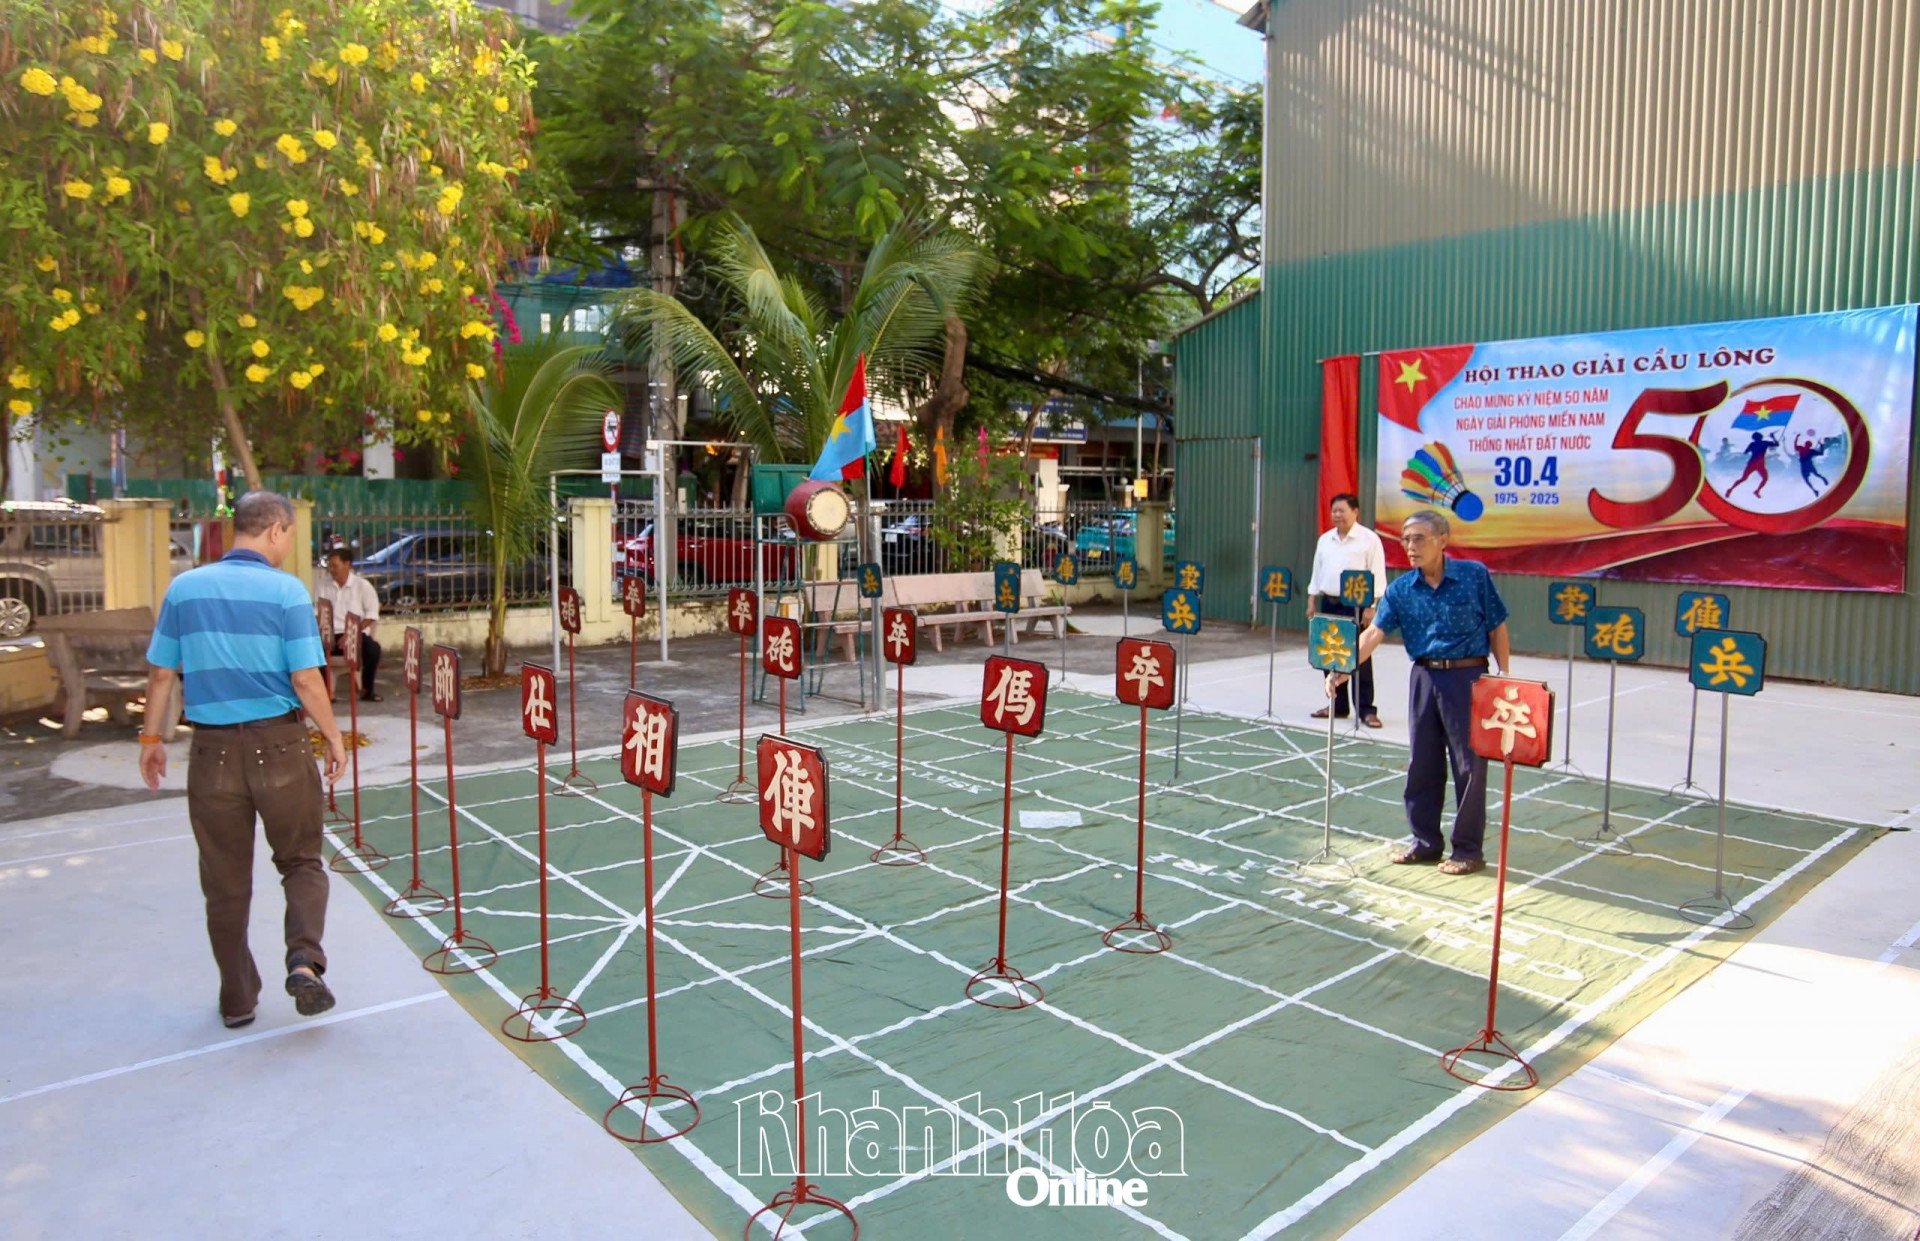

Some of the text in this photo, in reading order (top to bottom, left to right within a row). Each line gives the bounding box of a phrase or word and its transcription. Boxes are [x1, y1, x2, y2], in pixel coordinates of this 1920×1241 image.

[1465, 365, 1500, 386] HỘI
[1506, 363, 1566, 380] THAO
[1572, 353, 1625, 376] GIẢI
[1698, 346, 1775, 368] LÔNG
[1454, 394, 1482, 409] CHÀO
[1534, 389, 1562, 408] NIỆM
[1565, 390, 1580, 404] 50
[1583, 387, 1609, 403] NĂM
[1456, 415, 1483, 431] NGÀY
[1487, 412, 1506, 430] GIẢI
[1579, 412, 1605, 427] NAM
[1468, 433, 1501, 453] THỐNG
[1504, 433, 1532, 451] NHẤT
[1560, 433, 1591, 451] NƯỚC
[1588, 377, 1871, 535] 50
[1494, 456, 1559, 486] 30.4
[1494, 492, 1518, 505] 1975
[1530, 492, 1559, 505] 2025
[732, 592, 752, 631] 卒
[1167, 593, 1196, 629] 兵
[766, 626, 793, 672] 砲
[887, 613, 909, 658] 卒
[1316, 622, 1351, 667] 兵
[1591, 613, 1636, 655] 砲
[1124, 646, 1164, 702] 卒
[1700, 637, 1754, 687] 兵
[1481, 685, 1536, 756] 卒
[625, 704, 668, 782] 相
